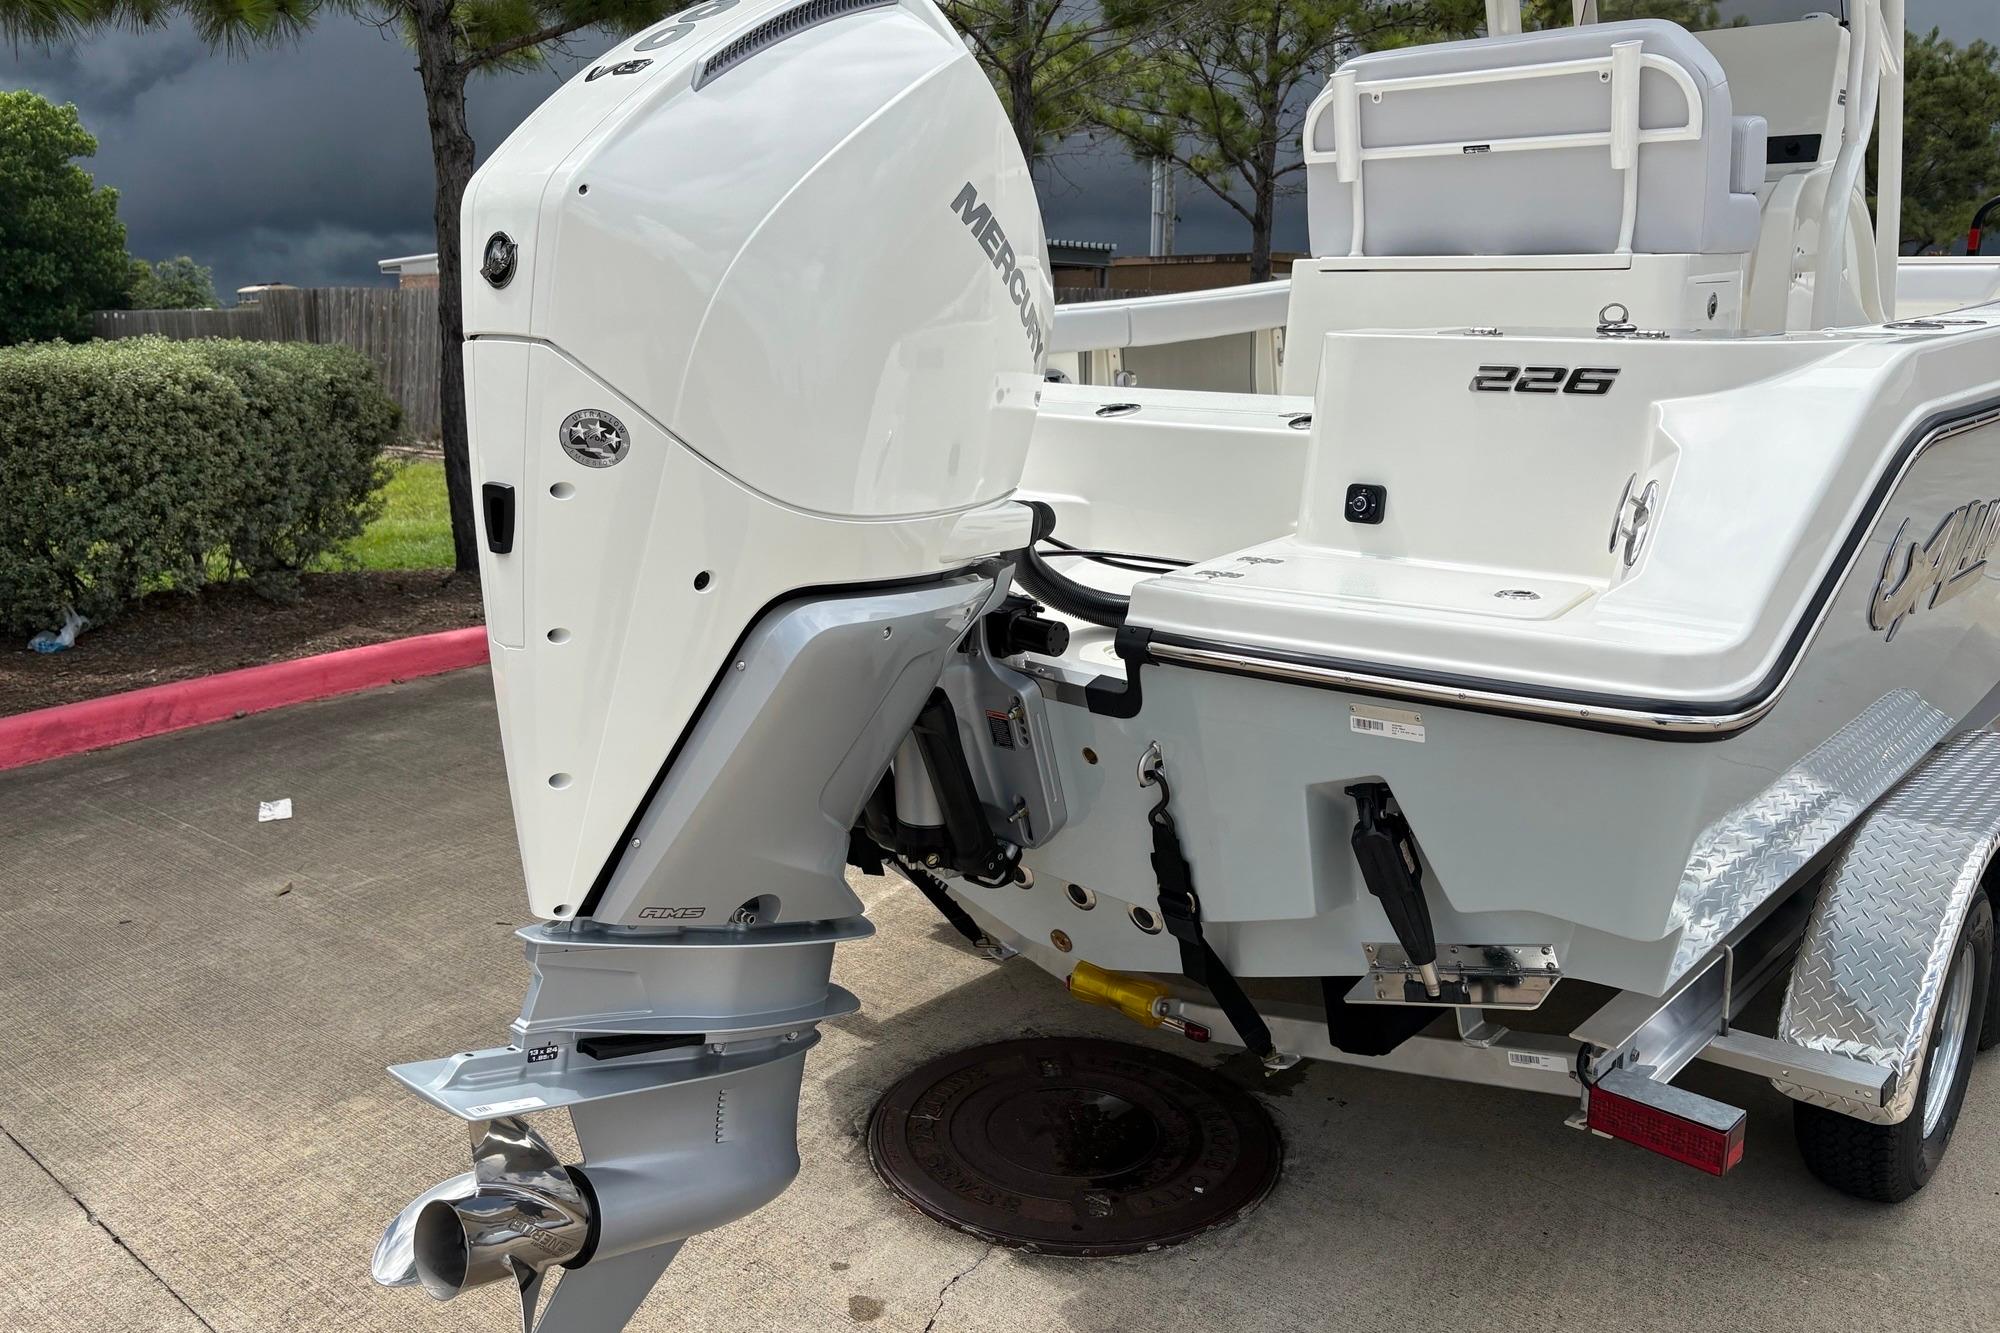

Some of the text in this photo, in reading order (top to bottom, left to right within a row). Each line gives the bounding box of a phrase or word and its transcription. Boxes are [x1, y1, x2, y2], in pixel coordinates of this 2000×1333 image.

[950, 181, 1043, 363] MERCURY
[1468, 364, 1622, 396] 226
[571, 411, 626, 434] ULTRA LOW
[638, 906, 706, 919] AMS
